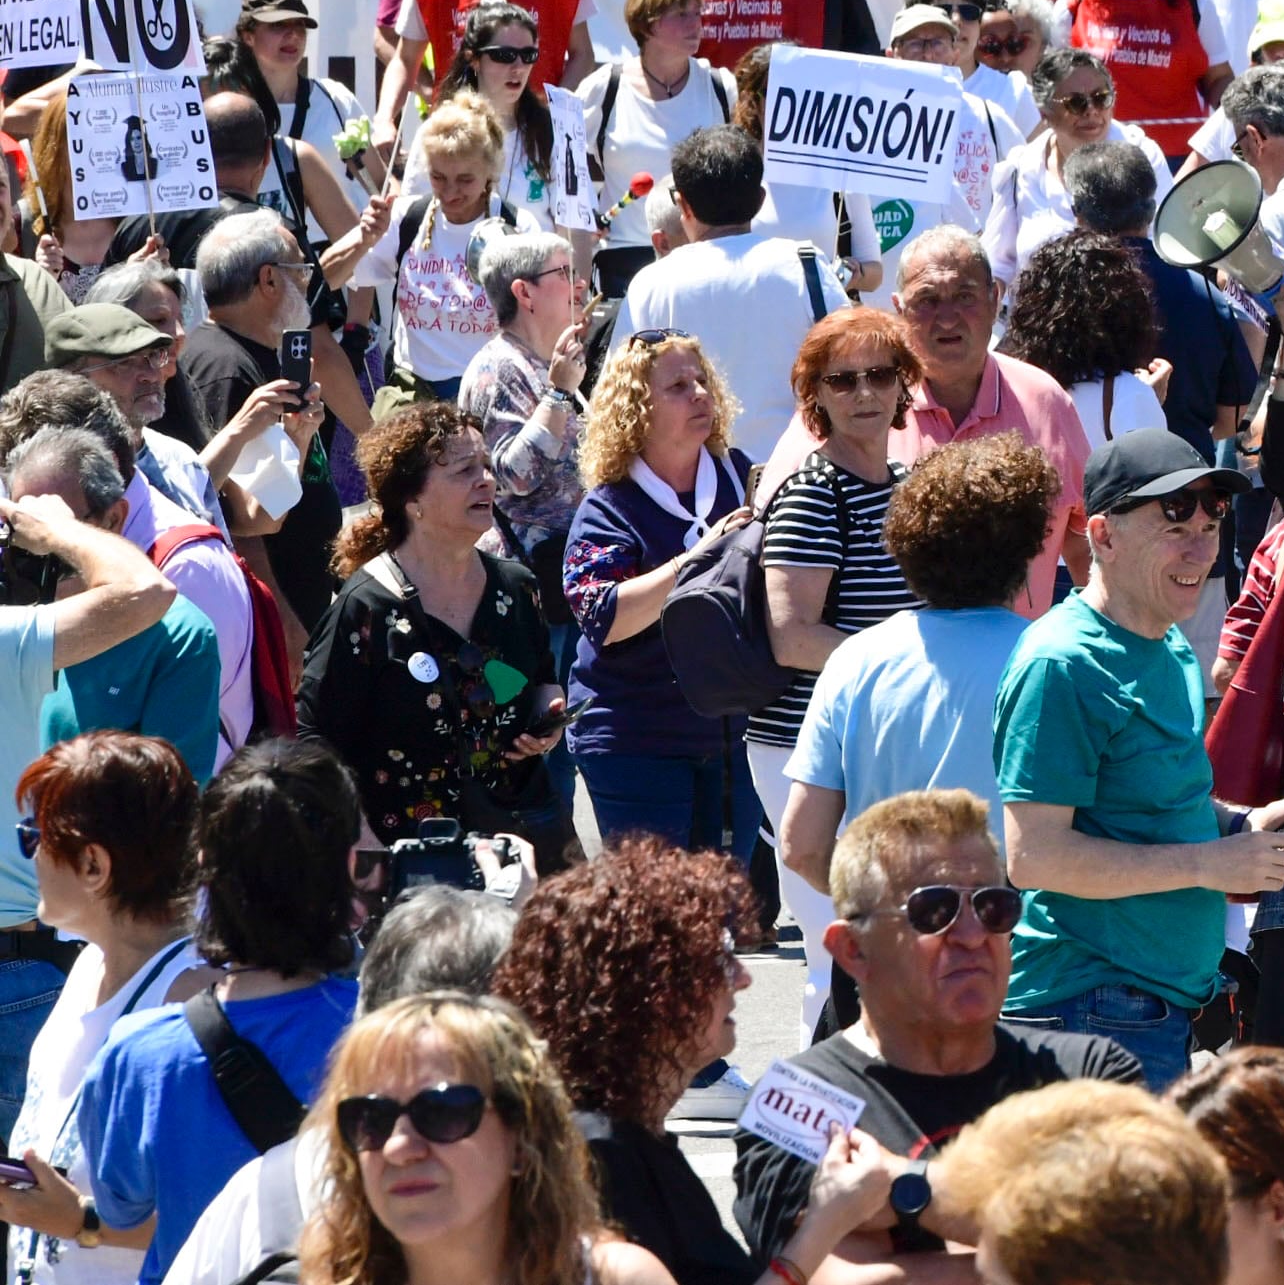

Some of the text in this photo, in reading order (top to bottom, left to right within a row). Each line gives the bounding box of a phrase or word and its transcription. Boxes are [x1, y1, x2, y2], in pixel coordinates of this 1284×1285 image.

[19, 15, 80, 52] LEGAL.
[723, 21, 750, 39] Pueblos
[750, 21, 760, 38] de
[760, 21, 783, 39] Madrid
[1127, 23, 1160, 43] Vecinos
[1160, 27, 1172, 45] de
[1146, 49, 1172, 69] Madrid
[86, 77, 134, 98] Alumna
[768, 87, 955, 165] DIMISIÓN!
[67, 82, 89, 210] AYUSO
[181, 75, 214, 201] ABUSO
[405, 290, 427, 310] DE
[800, 1076, 809, 1088] LA
